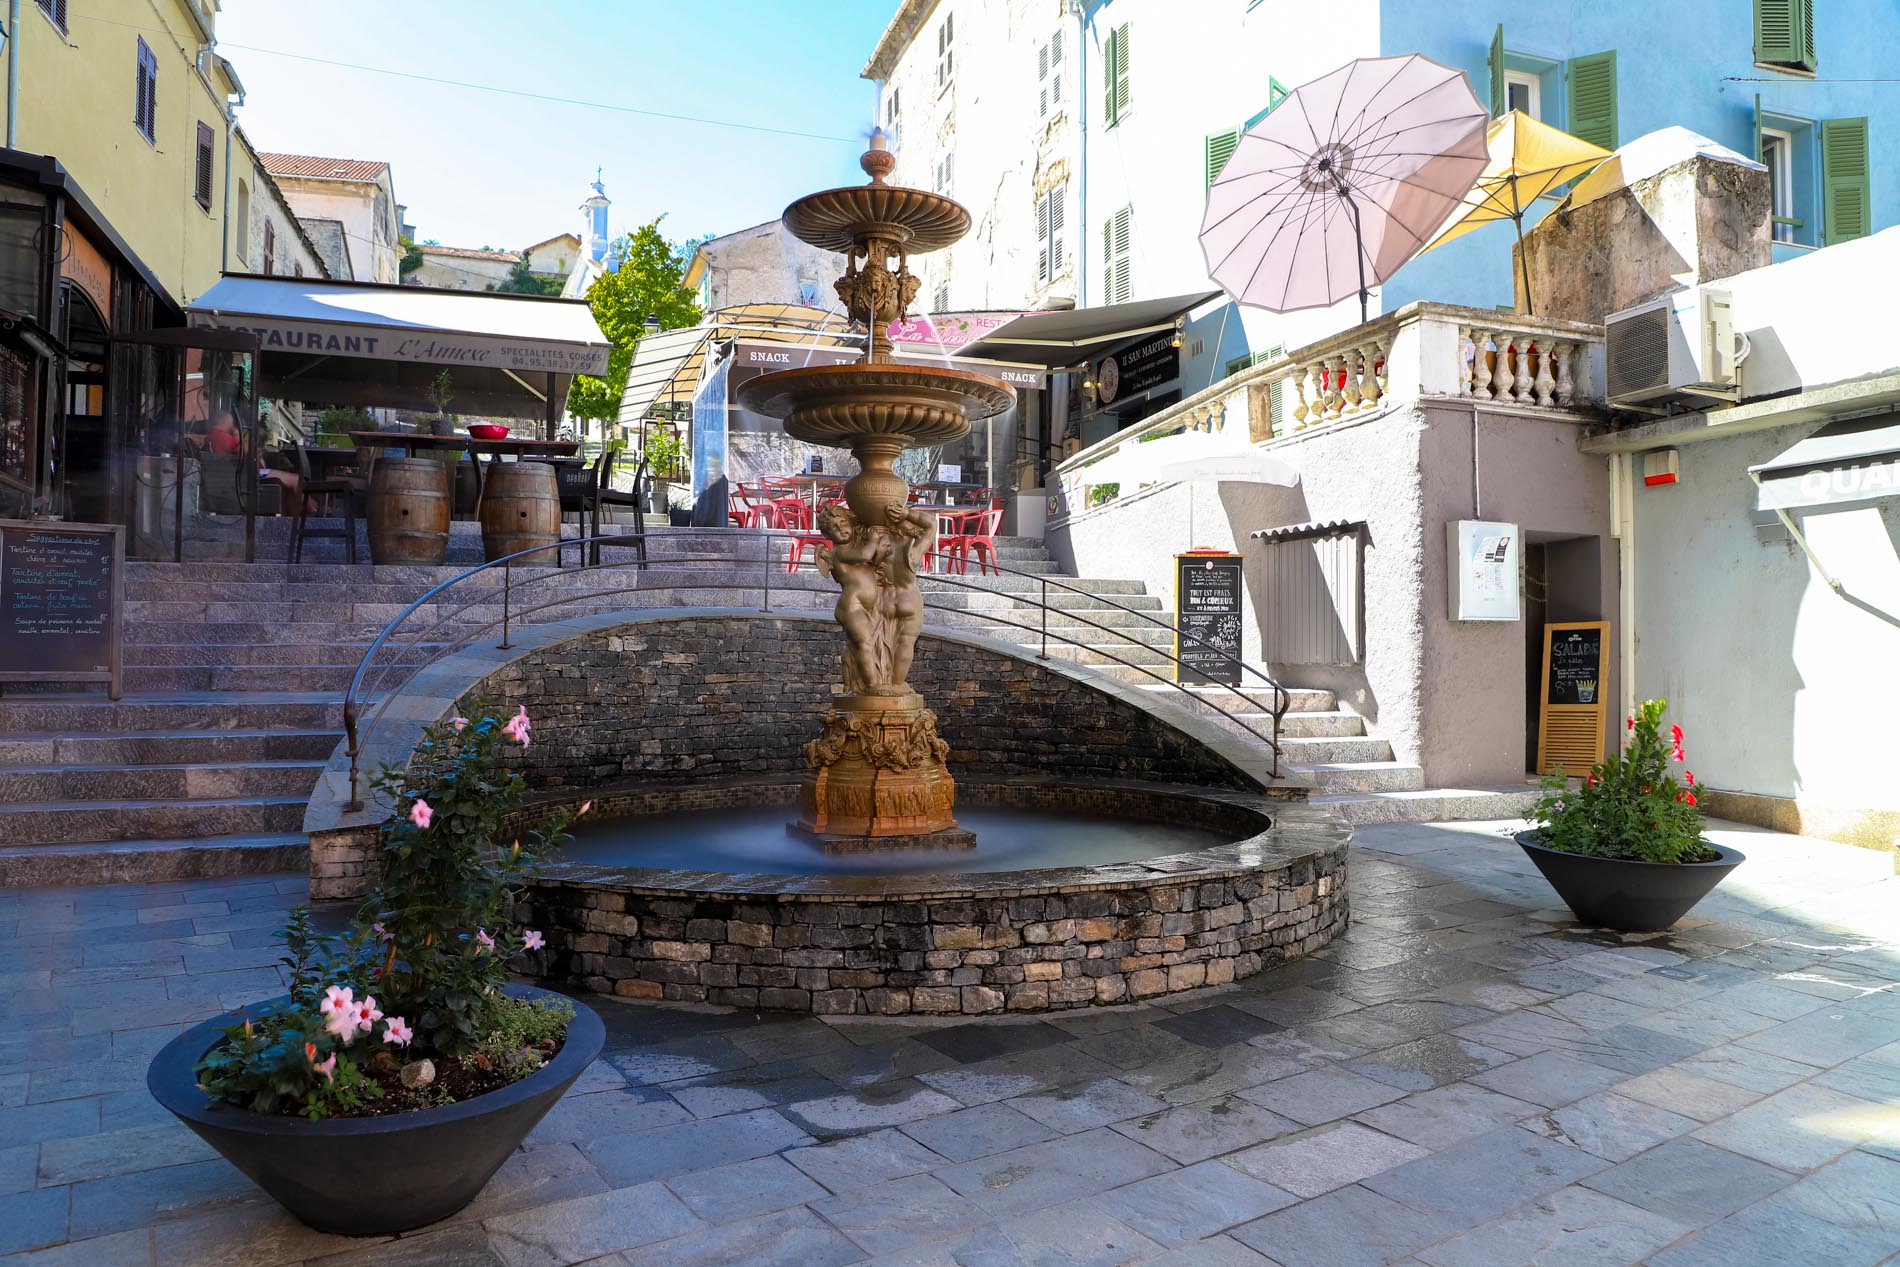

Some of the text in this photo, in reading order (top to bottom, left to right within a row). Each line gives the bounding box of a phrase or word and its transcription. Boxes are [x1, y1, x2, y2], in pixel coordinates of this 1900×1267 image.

[891, 322, 923, 341] La
[394, 339, 491, 361] L'Annexe
[569, 352, 602, 362] CORSES
[750, 351, 790, 363] SNACK
[1128, 349, 1141, 364] SAN
[1001, 371, 1036, 383] SNACK
[1190, 589, 1203, 597] TOUT
[1203, 589, 1213, 597] EST
[1201, 596, 1206, 605] &
[38, 617, 47, 625] de
